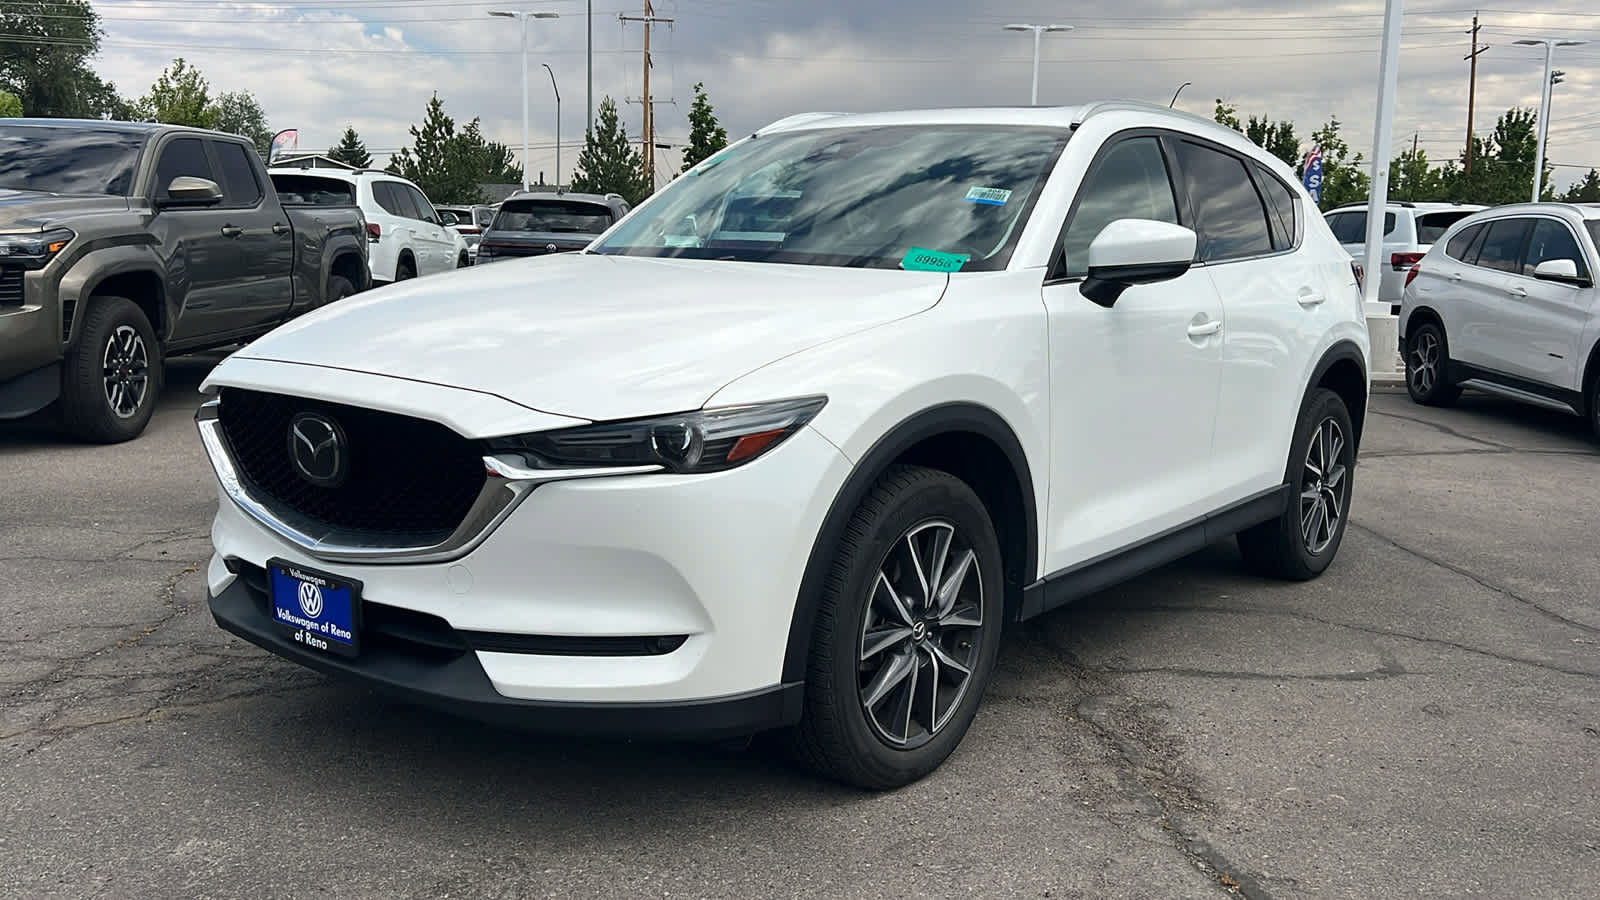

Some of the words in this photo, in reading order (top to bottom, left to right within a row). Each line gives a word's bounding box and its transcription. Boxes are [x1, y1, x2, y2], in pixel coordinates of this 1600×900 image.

[289, 568, 326, 586] Volkswagen
[276, 607, 319, 630] Volkswagen
[320, 621, 329, 633] of
[330, 623, 352, 639] Reno
[294, 629, 303, 642] of
[305, 631, 328, 650] Reno
